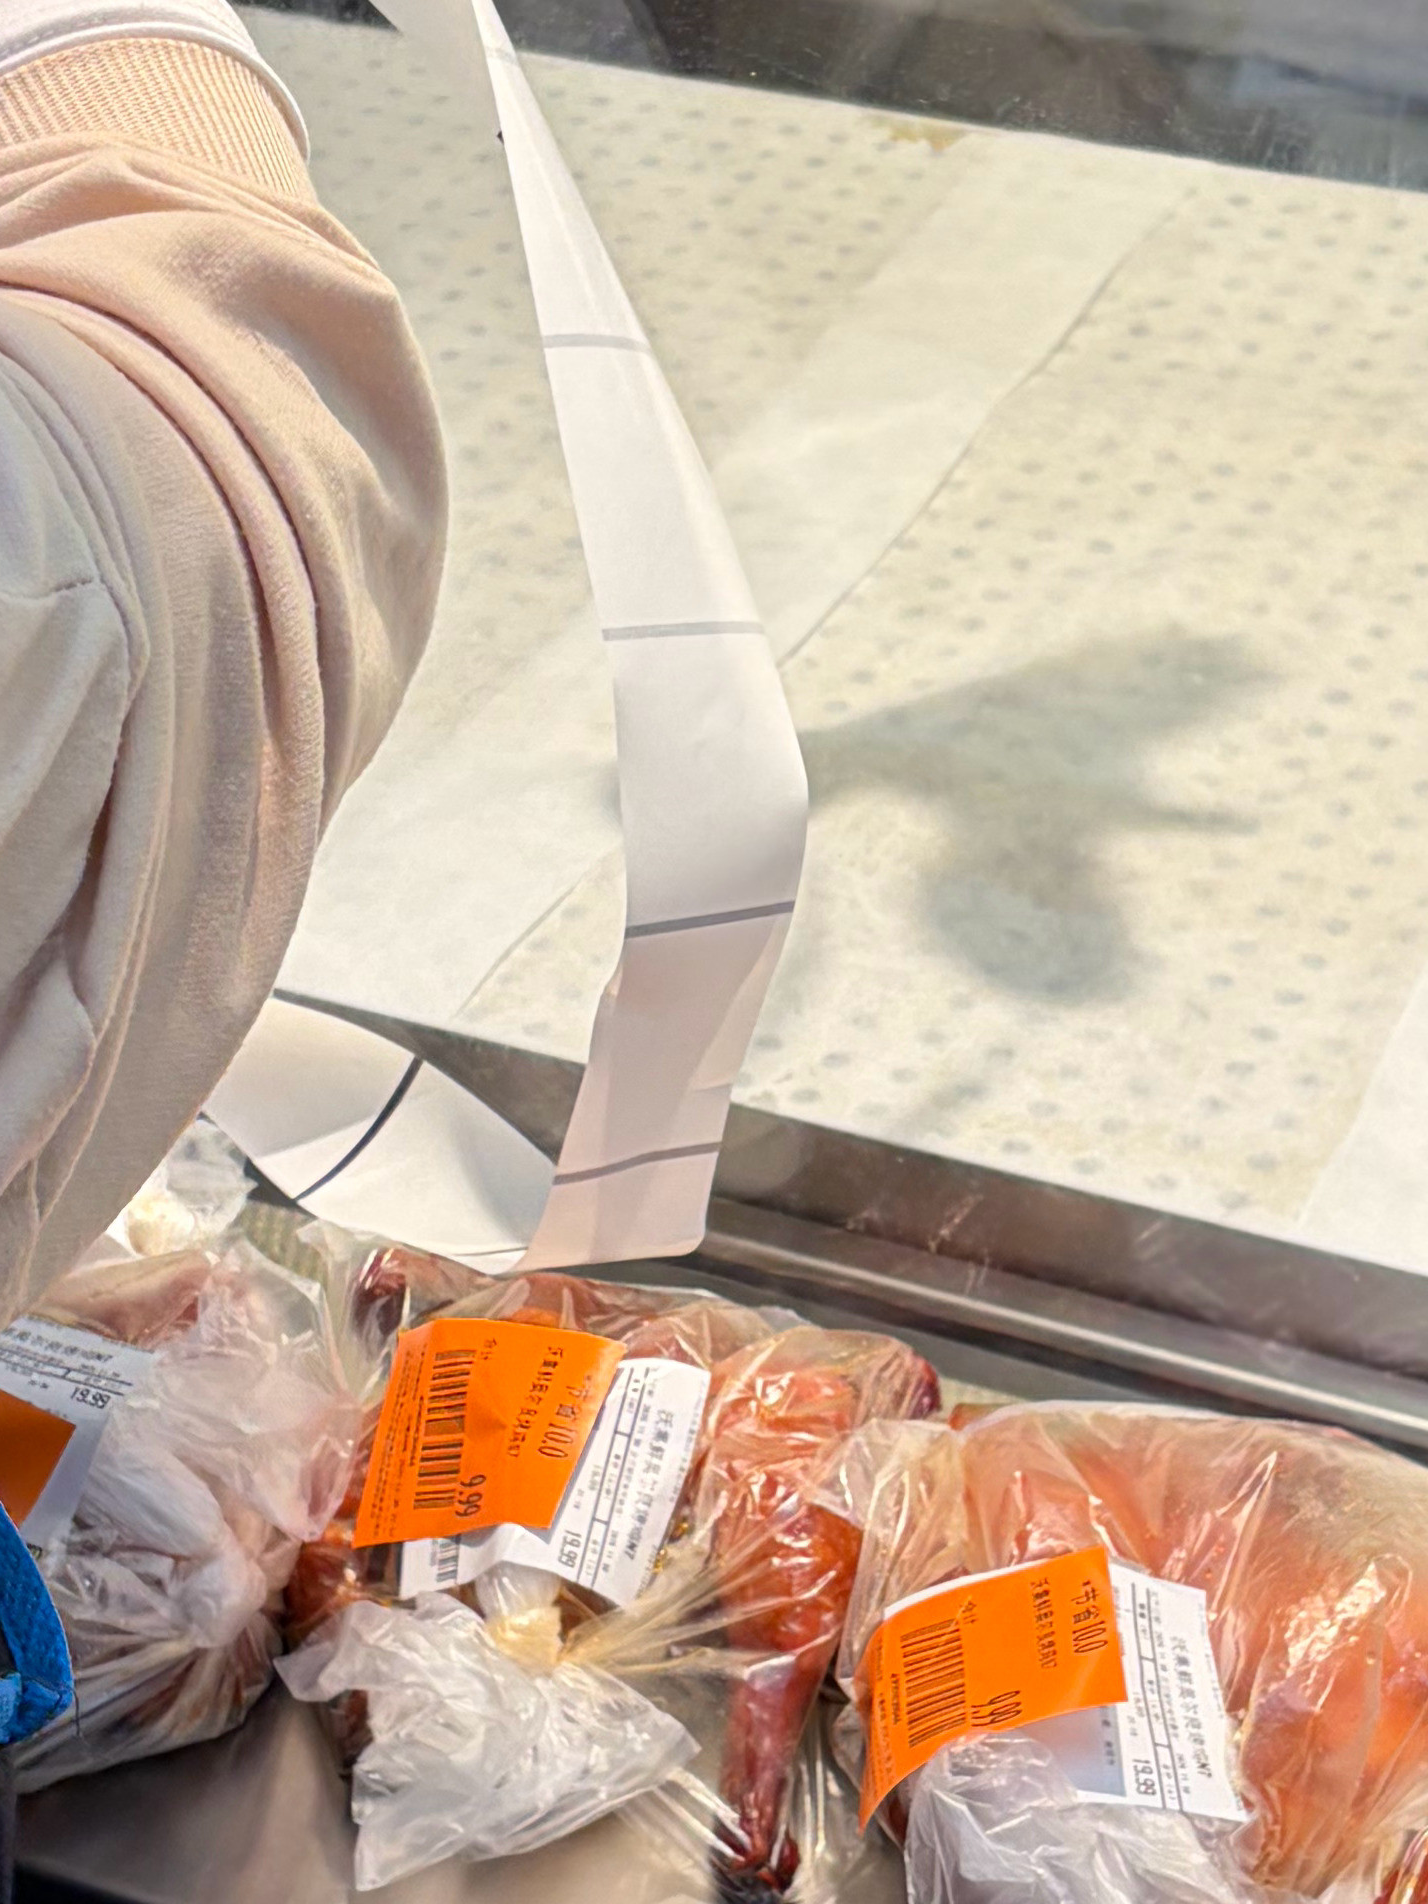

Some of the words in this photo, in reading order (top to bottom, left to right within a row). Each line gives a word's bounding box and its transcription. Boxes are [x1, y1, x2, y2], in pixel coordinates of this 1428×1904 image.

[70, 1385, 112, 1410] 19.99
[452, 1475, 486, 1517] 9.99
[558, 1530, 581, 1568] 19.99
[972, 1691, 1021, 1727] 9.99
[1134, 1759, 1156, 1796] 19.99
